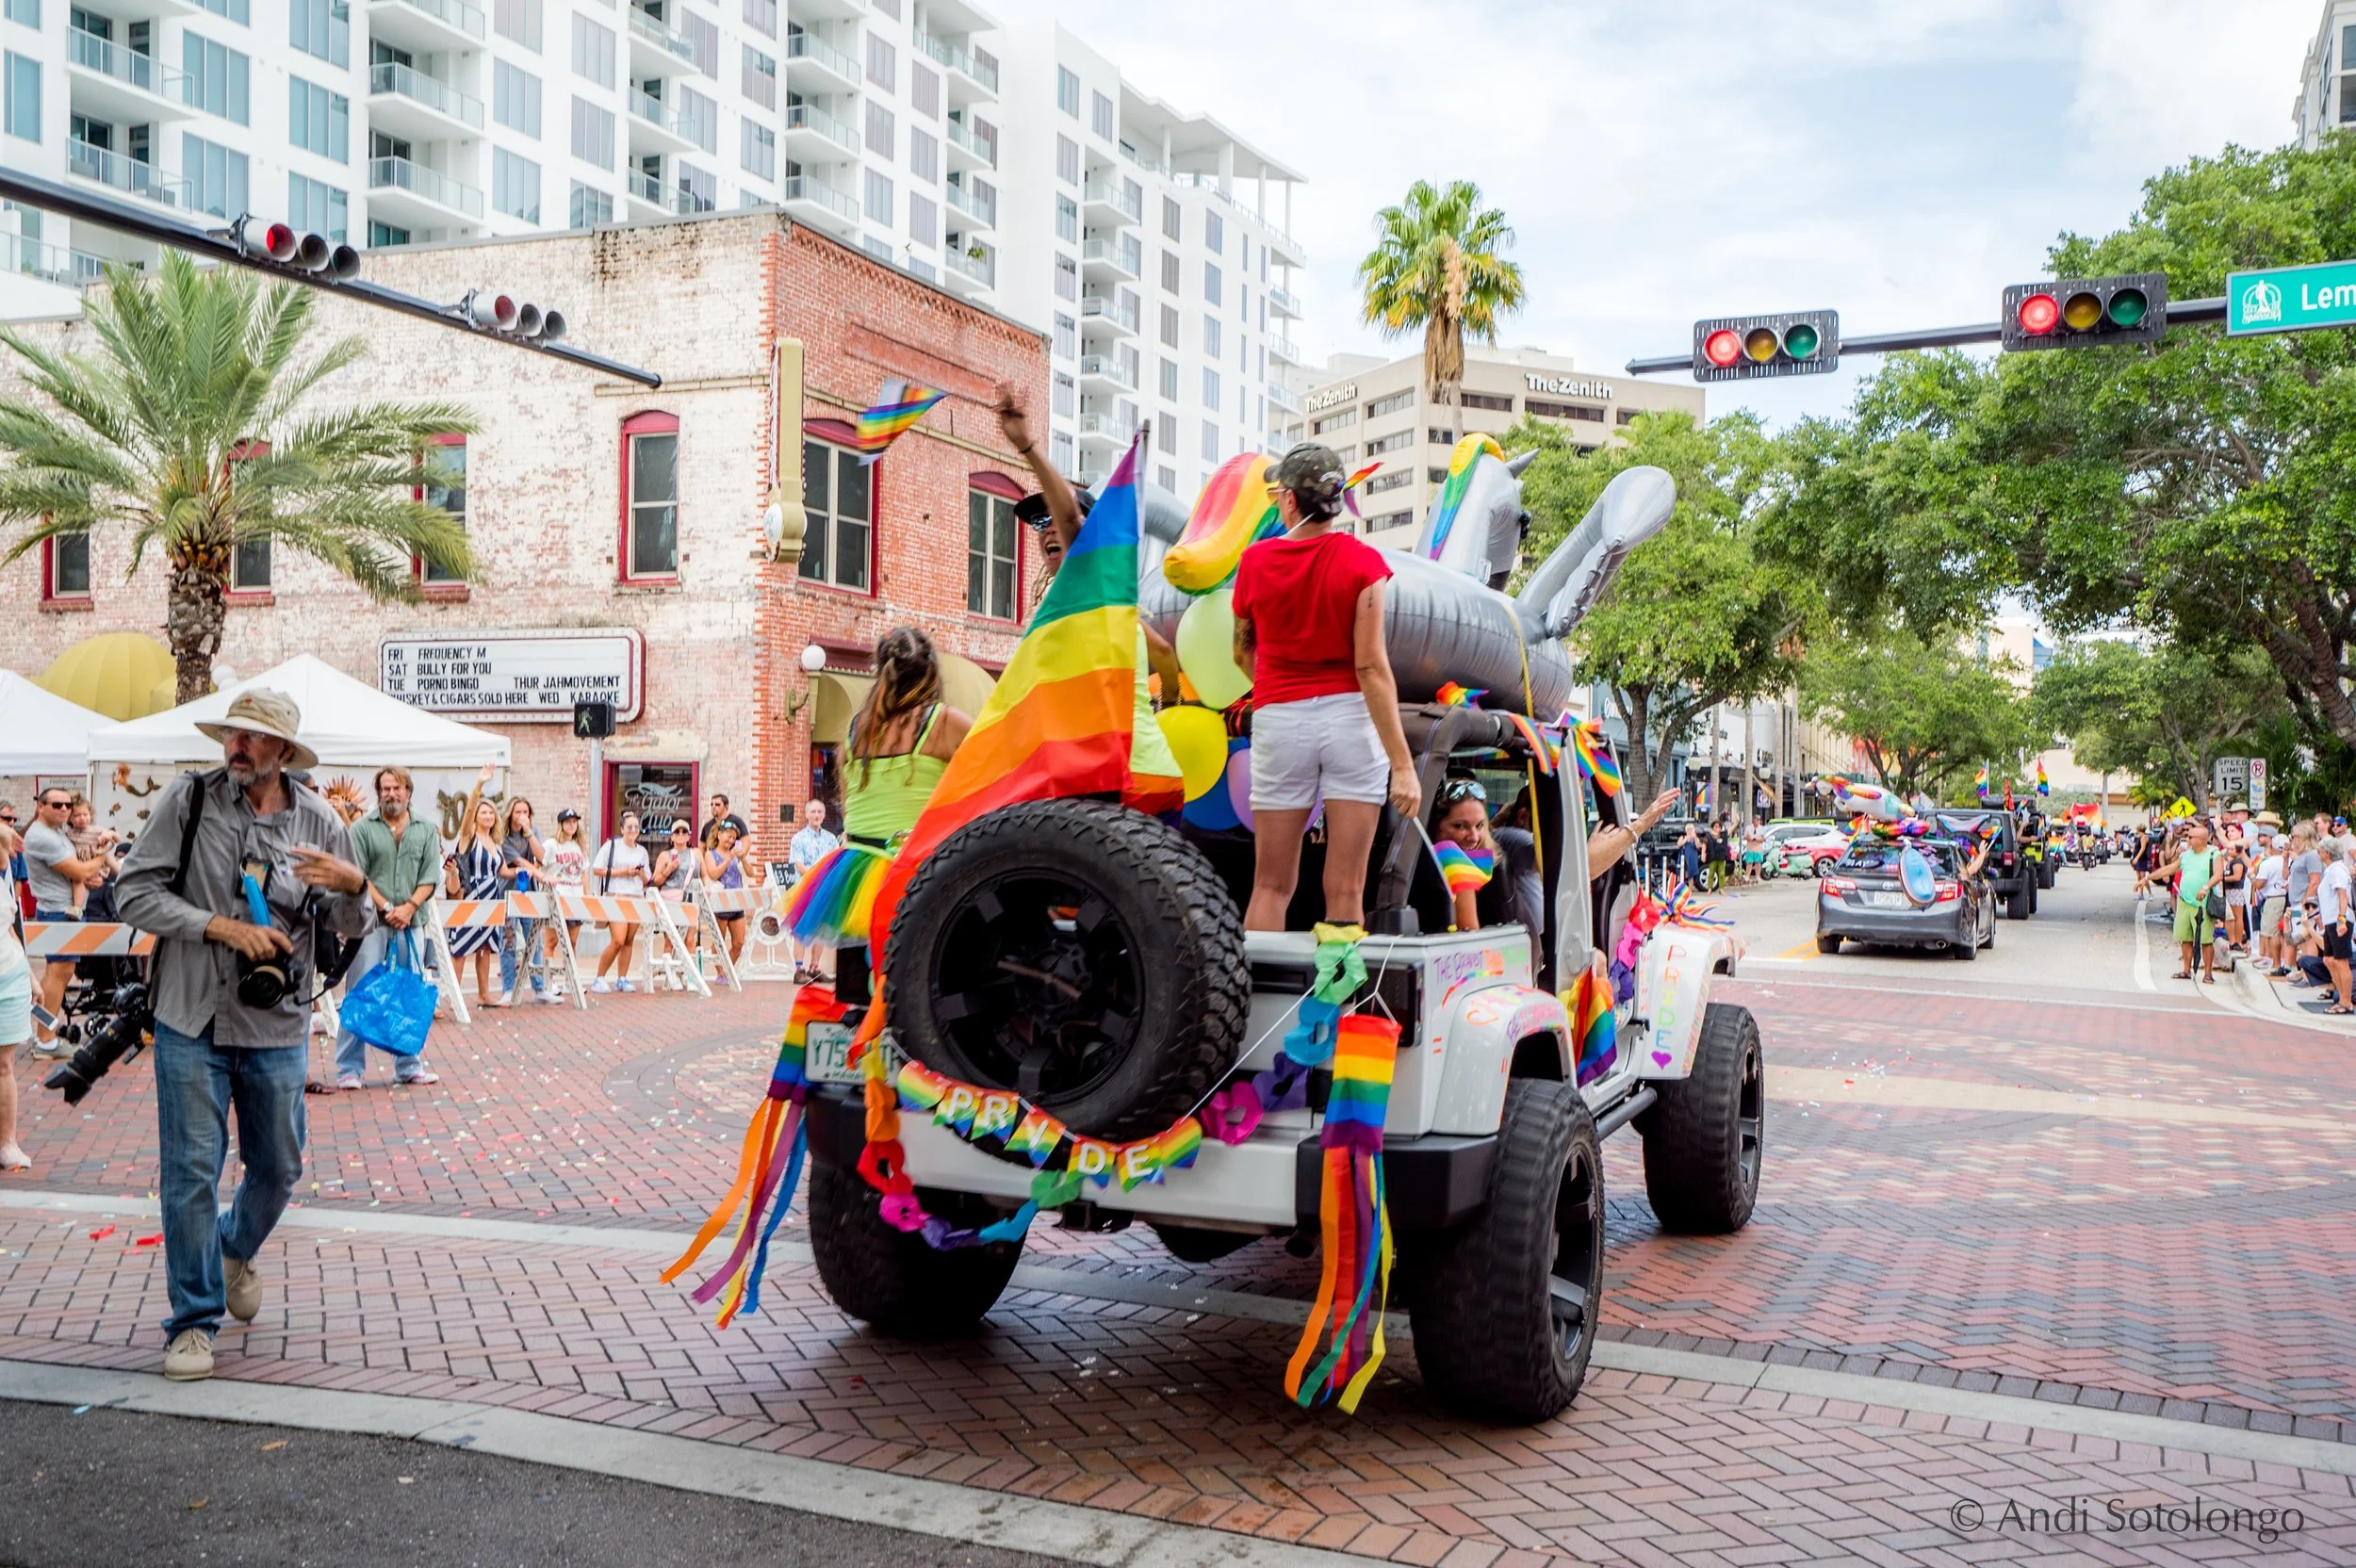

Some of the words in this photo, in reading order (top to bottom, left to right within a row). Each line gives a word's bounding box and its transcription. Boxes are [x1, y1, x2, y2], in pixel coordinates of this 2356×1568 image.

[388, 648, 403, 661] FRI
[477, 646, 486, 659] M
[389, 663, 407, 676] SAT
[417, 662, 447, 676] BULLY
[451, 662, 469, 676] FOR
[473, 662, 492, 675] YOU
[388, 678, 405, 691] TUE
[417, 678, 449, 691] PORNO
[450, 678, 479, 690] BINGO
[514, 676, 539, 689] THUR
[544, 675, 620, 689] JAHMOVEMENT
[432, 693, 437, 705] &
[440, 693, 476, 705] CIGARS
[478, 692, 502, 705] SOLD
[505, 692, 528, 705] HERE
[539, 692, 560, 705] WED
[2221, 776, 2243, 791] 15
[642, 792, 682, 816] Gator
[641, 811, 673, 830] Club
[1656, 944, 1687, 1050] PRIDE
[945, 1086, 1153, 1179] PRIDE
